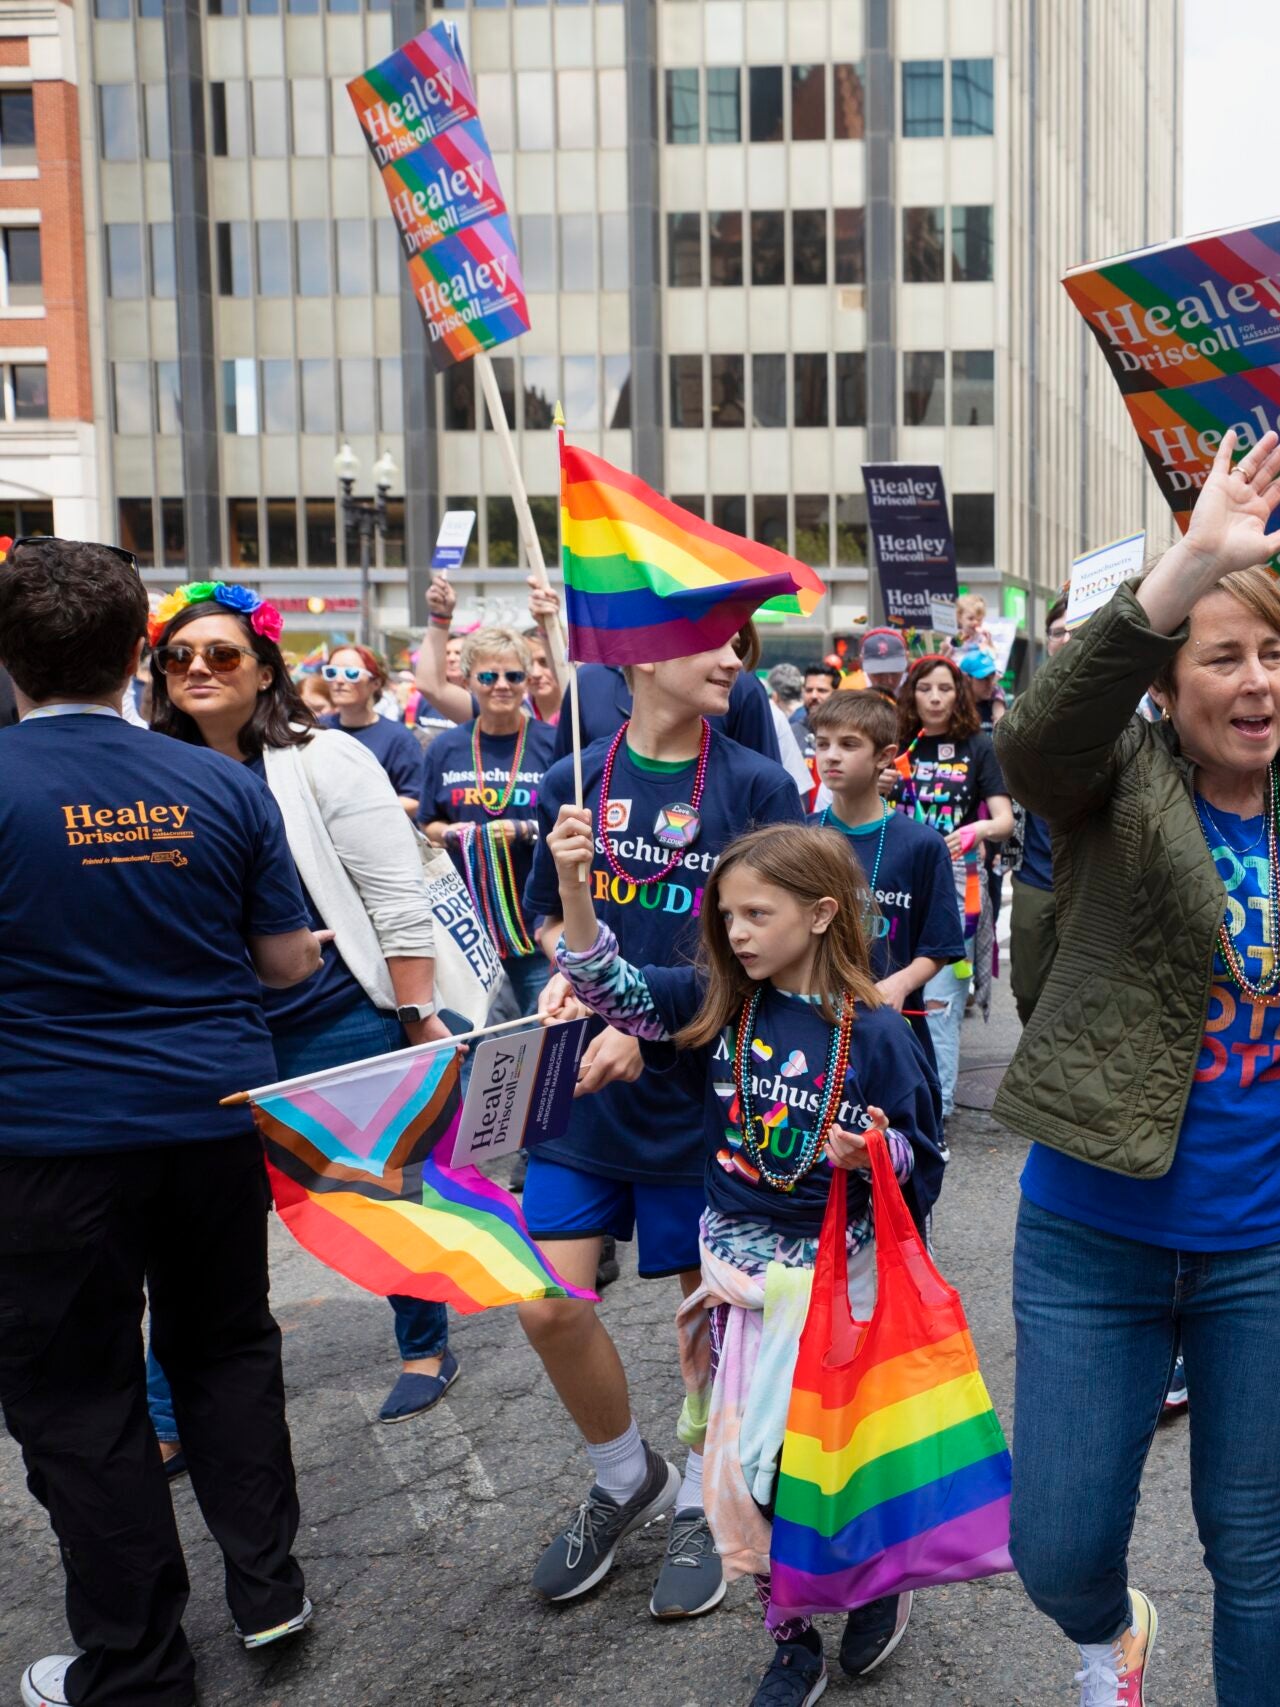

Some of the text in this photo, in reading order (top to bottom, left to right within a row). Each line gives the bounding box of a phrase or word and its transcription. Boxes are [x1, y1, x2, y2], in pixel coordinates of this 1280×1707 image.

[363, 65, 453, 143] Healey
[375, 114, 437, 166] Driscoll
[394, 159, 485, 230] Healey
[404, 205, 460, 253] Driscoll
[419, 254, 508, 320] Healey
[428, 298, 483, 342] Driscoll
[1116, 324, 1255, 372] Driscoll FOR
[869, 477, 937, 499] Healey
[872, 495, 917, 507] Driscoll
[878, 534, 946, 556] Healey
[880, 552, 924, 562] Driscoll
[1081, 557, 1132, 580] Massachusetts
[61, 800, 190, 829] Healey
[671, 804, 690, 816] Love
[66, 825, 150, 846] Driscoll
[587, 870, 705, 918] ROUD!
[470, 1051, 515, 1152] Healey
[537, 1042, 559, 1122] PROUD TO BE BUILDING
[493, 1080, 519, 1145] Driscoll
[543, 1088, 555, 1124] STRONGER
